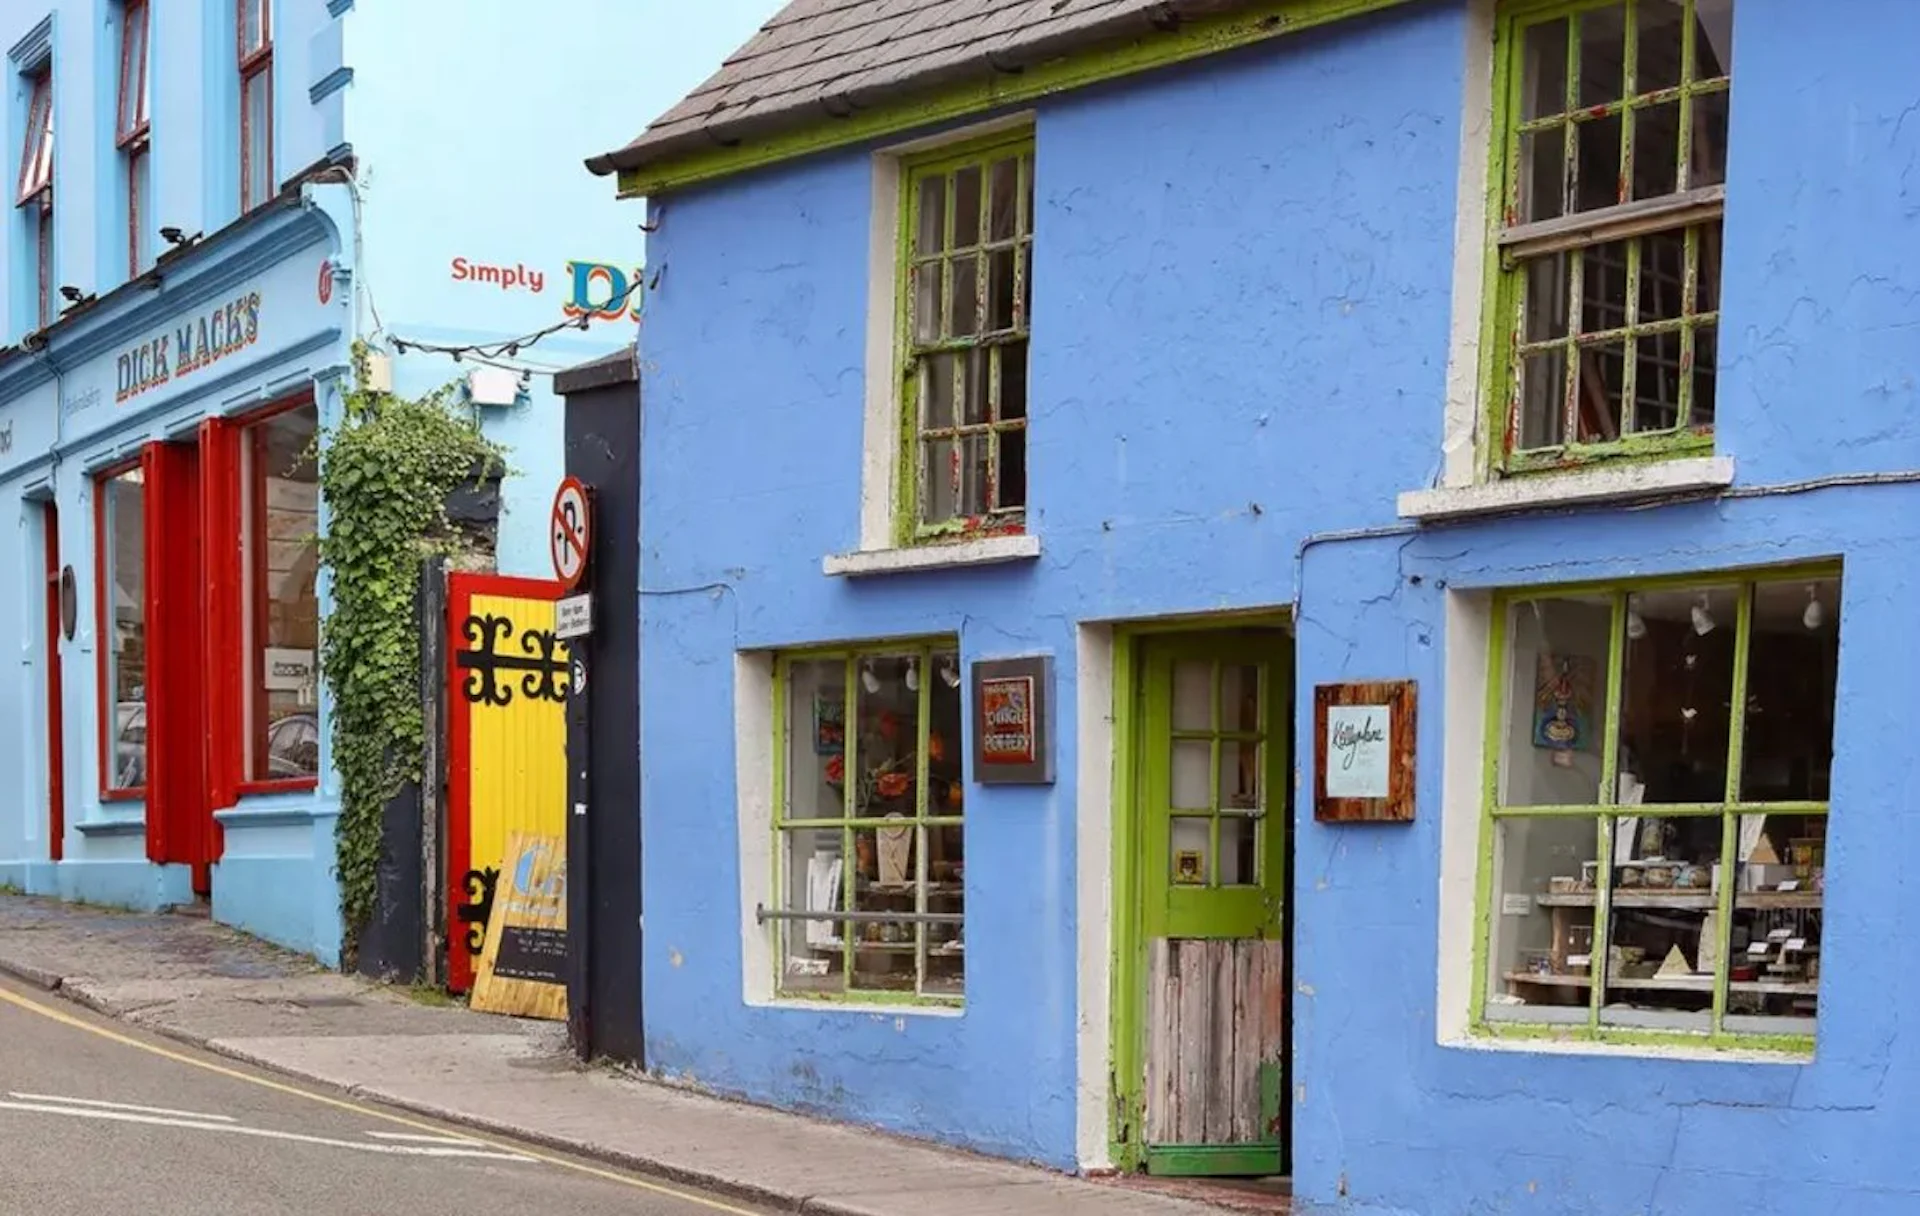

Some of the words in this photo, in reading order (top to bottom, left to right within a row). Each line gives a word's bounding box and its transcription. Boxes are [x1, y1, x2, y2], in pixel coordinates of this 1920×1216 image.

[451, 256, 544, 293] Simply
[116, 334, 170, 402] DICK
[175, 291, 261, 377] MACK'S
